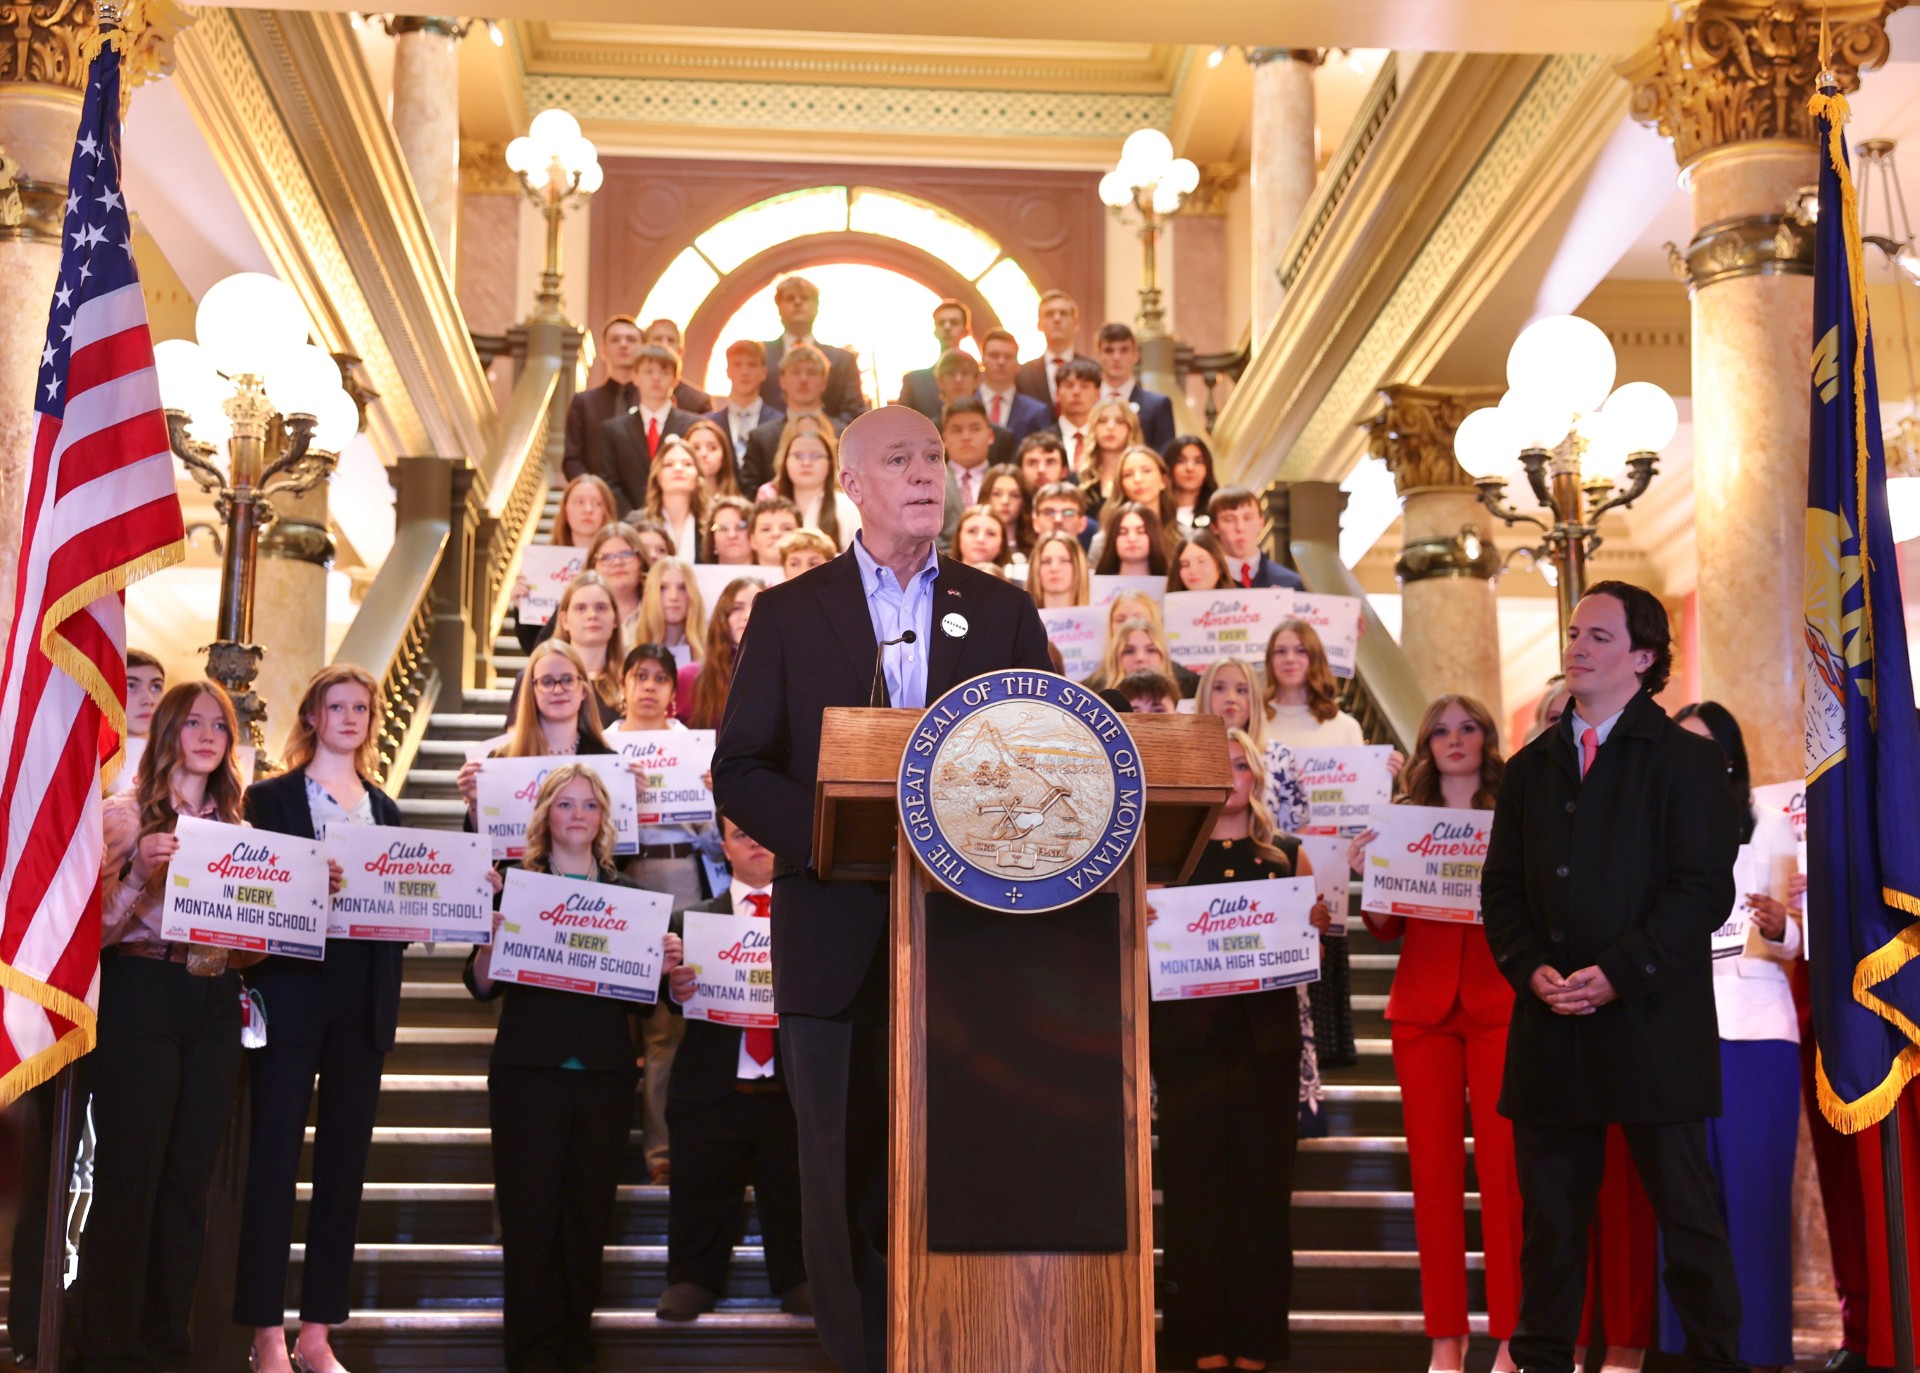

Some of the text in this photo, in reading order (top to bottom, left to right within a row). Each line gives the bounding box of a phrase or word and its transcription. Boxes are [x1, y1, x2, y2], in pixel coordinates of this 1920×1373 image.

[1210, 599, 1241, 615] Club
[1192, 611, 1261, 629] America
[1219, 630, 1247, 641] EVERY
[1170, 645, 1215, 656] MONTANA
[1219, 643, 1242, 654] HIGH
[1303, 757, 1337, 774] Club
[906, 677, 1139, 890] THE GREAT SEAL OF THE STATE OF MONTANA
[661, 789, 706, 803] SCHOOL!
[1311, 789, 1343, 802] EVERY
[1311, 804, 1336, 817] HIGH
[1433, 822, 1474, 841] Club
[232, 842, 269, 862] Club
[388, 841, 428, 860] Club
[1407, 833, 1488, 857] Americ
[207, 853, 292, 883] America
[364, 853, 454, 876] America
[1426, 862, 1481, 878] IN EVERY
[223, 884, 273, 905] IN EVERY
[384, 881, 436, 897] IN EVERY
[1374, 875, 1437, 895] MONTANA
[1442, 882, 1472, 898] HIGH
[332, 897, 483, 919] MONTANA HIGH SCHOOL!
[566, 893, 606, 912] Club
[1209, 895, 1248, 918] Club
[174, 897, 232, 920] MONTANA
[237, 906, 264, 925] HIGH
[268, 911, 317, 933] SCHOOL!
[539, 903, 629, 932] America
[1186, 911, 1278, 936] America
[555, 931, 607, 951] IN EVERY
[742, 930, 770, 948] Clu
[1207, 935, 1260, 951] IN EVERY
[503, 941, 651, 978] MONTANA HIGH SCHOOL!
[1160, 947, 1310, 975] MONTANA HIGH SCHOOL!
[735, 969, 772, 984] IN EVE
